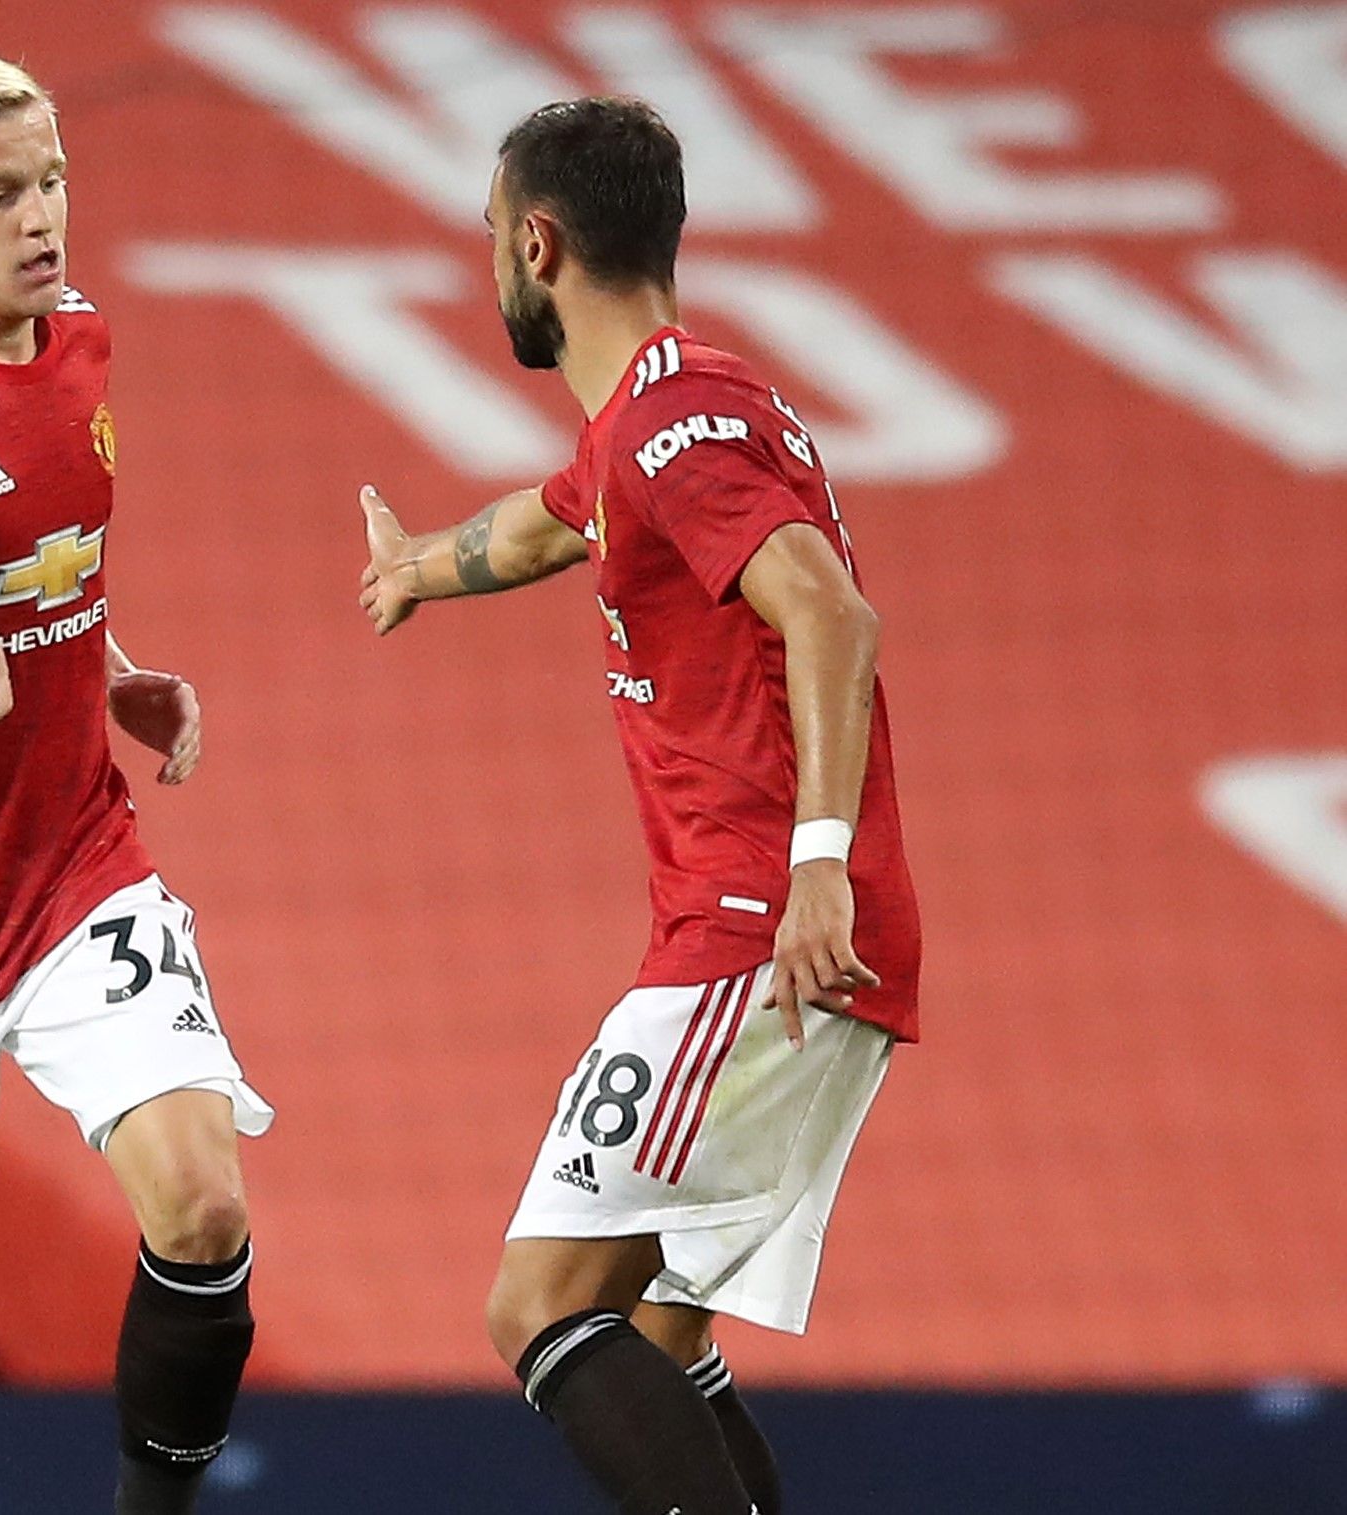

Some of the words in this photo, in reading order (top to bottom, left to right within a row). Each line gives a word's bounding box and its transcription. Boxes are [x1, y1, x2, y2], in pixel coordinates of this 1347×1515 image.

[156, 4, 1233, 234] WE
[634, 413, 751, 478] KOHLER
[89, 914, 205, 1005] 34
[558, 1048, 652, 1147] 18
[552, 1169, 600, 1195] adidas
